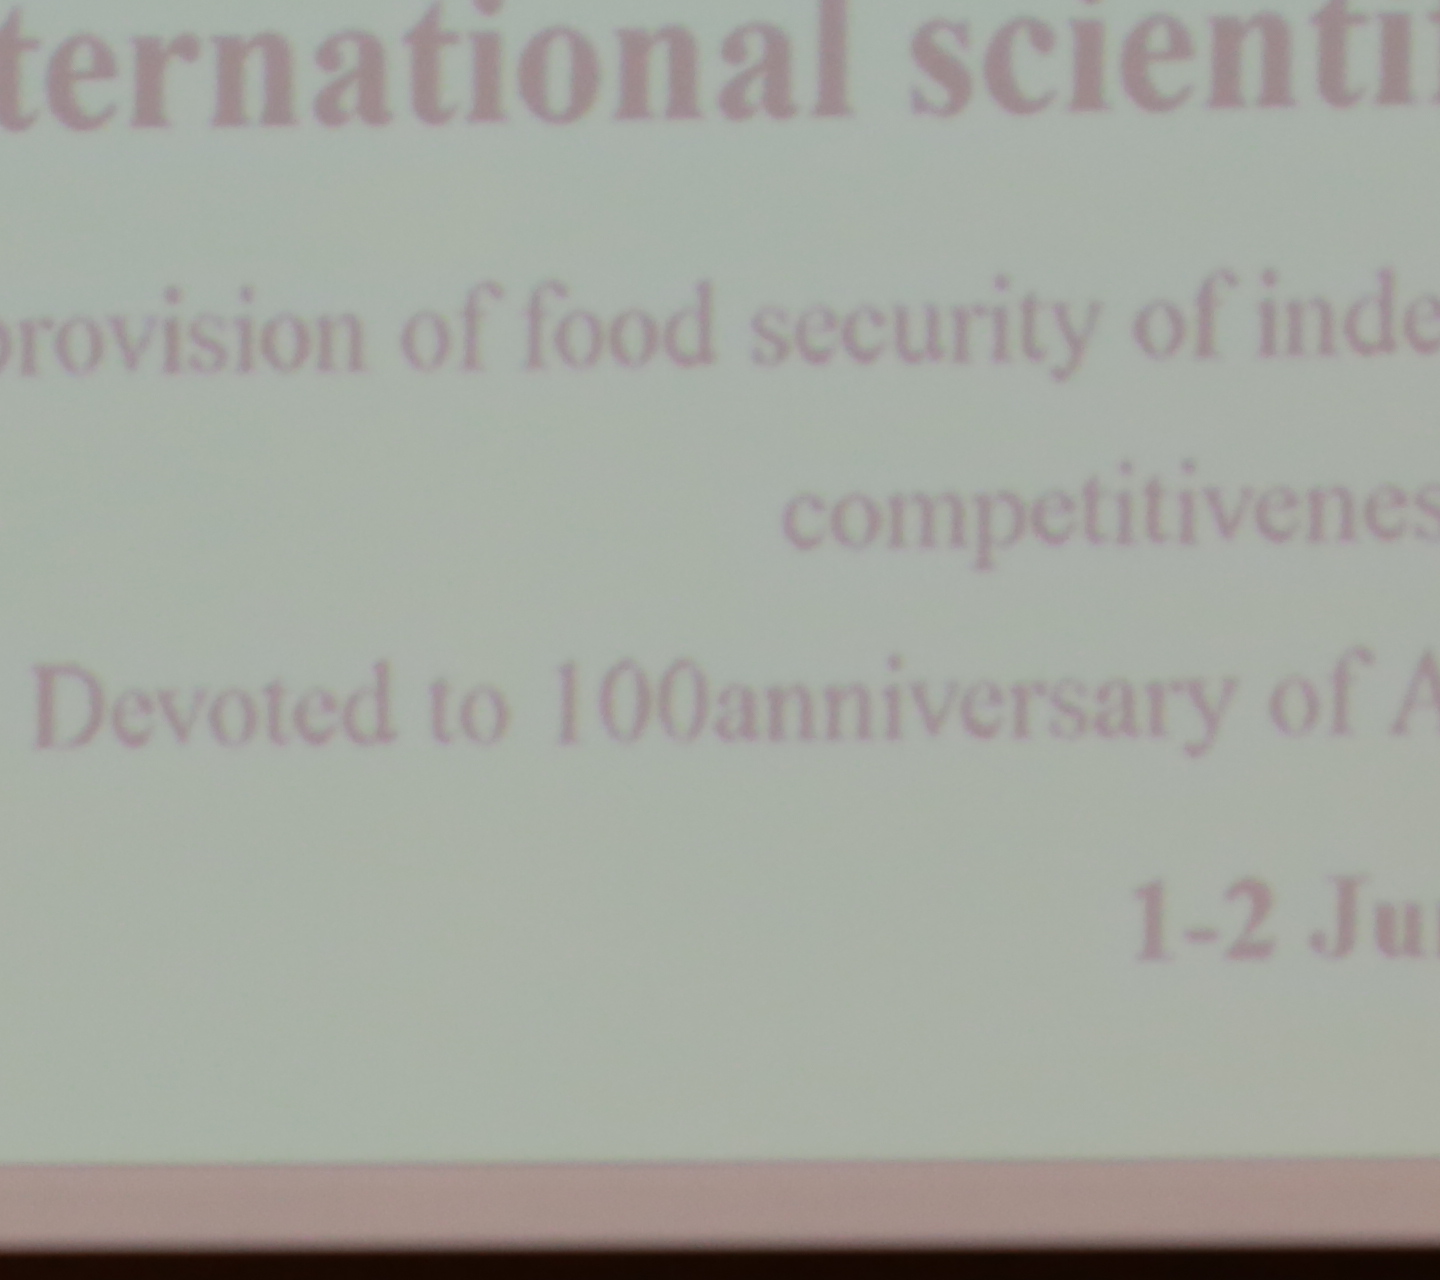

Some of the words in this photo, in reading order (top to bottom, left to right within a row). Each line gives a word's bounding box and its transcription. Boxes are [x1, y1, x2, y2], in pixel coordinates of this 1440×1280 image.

[399, 280, 504, 376] of
[523, 279, 716, 373] food
[750, 274, 1102, 384] security
[1131, 268, 1238, 362] of
[31, 657, 398, 751] Devoted
[428, 678, 511, 747] to
[557, 657, 1238, 760] 100anniversary
[1268, 646, 1375, 738] of
[1133, 876, 1276, 964] 1-2
